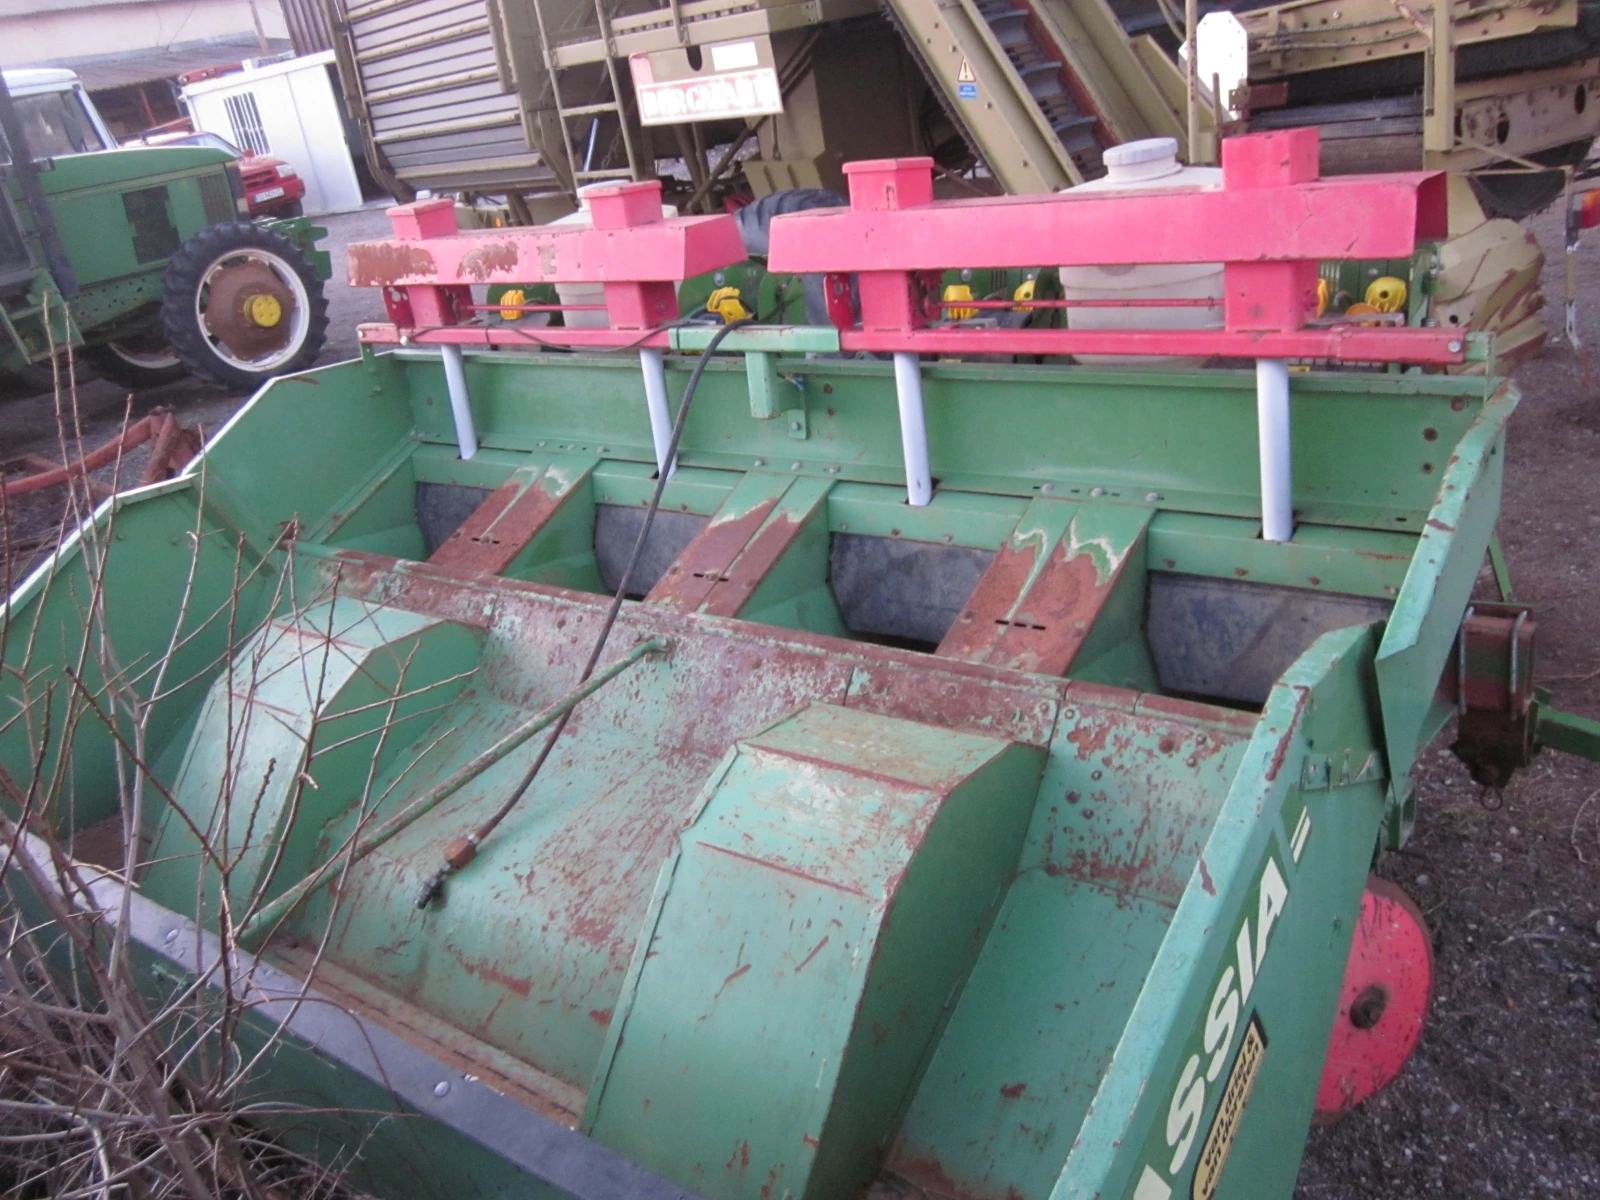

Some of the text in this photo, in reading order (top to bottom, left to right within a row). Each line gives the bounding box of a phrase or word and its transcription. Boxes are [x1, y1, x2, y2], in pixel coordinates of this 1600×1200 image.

[1202, 1146, 1222, 1196] van
[1222, 1042, 1260, 1144] dorsten
[1205, 1117, 1226, 1166] van
[1225, 1050, 1248, 1115] driel
